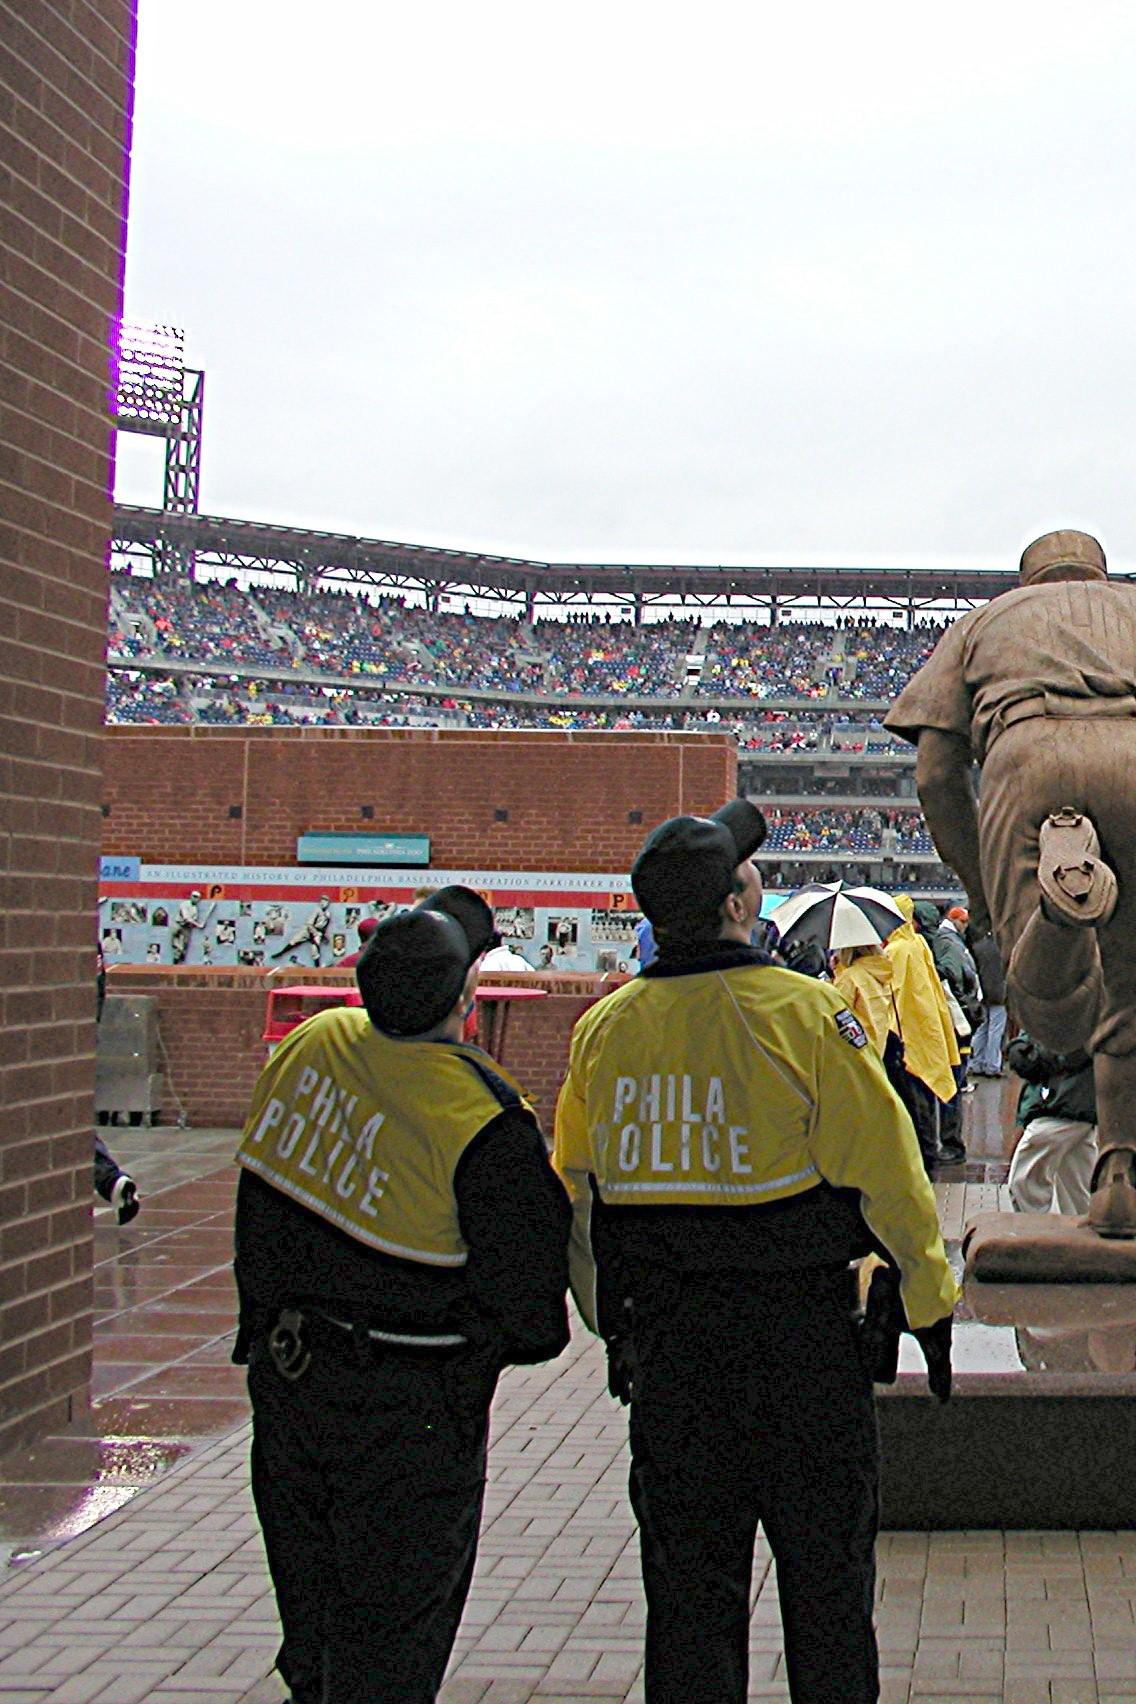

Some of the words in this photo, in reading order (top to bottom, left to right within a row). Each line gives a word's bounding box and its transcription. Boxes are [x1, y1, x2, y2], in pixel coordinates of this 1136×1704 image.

[165, 871, 238, 880] ILLUSTRATED
[243, 872, 289, 881] HISTORY
[294, 874, 306, 882] OF
[313, 874, 393, 884] PHILADELPHIA
[399, 876, 451, 884] BASEBALL
[461, 877, 529, 887] RECREATION
[612, 894, 625, 908] P
[295, 1065, 386, 1160] PHILA
[612, 1073, 726, 1124] PHILA
[254, 1098, 390, 1218] POLICE
